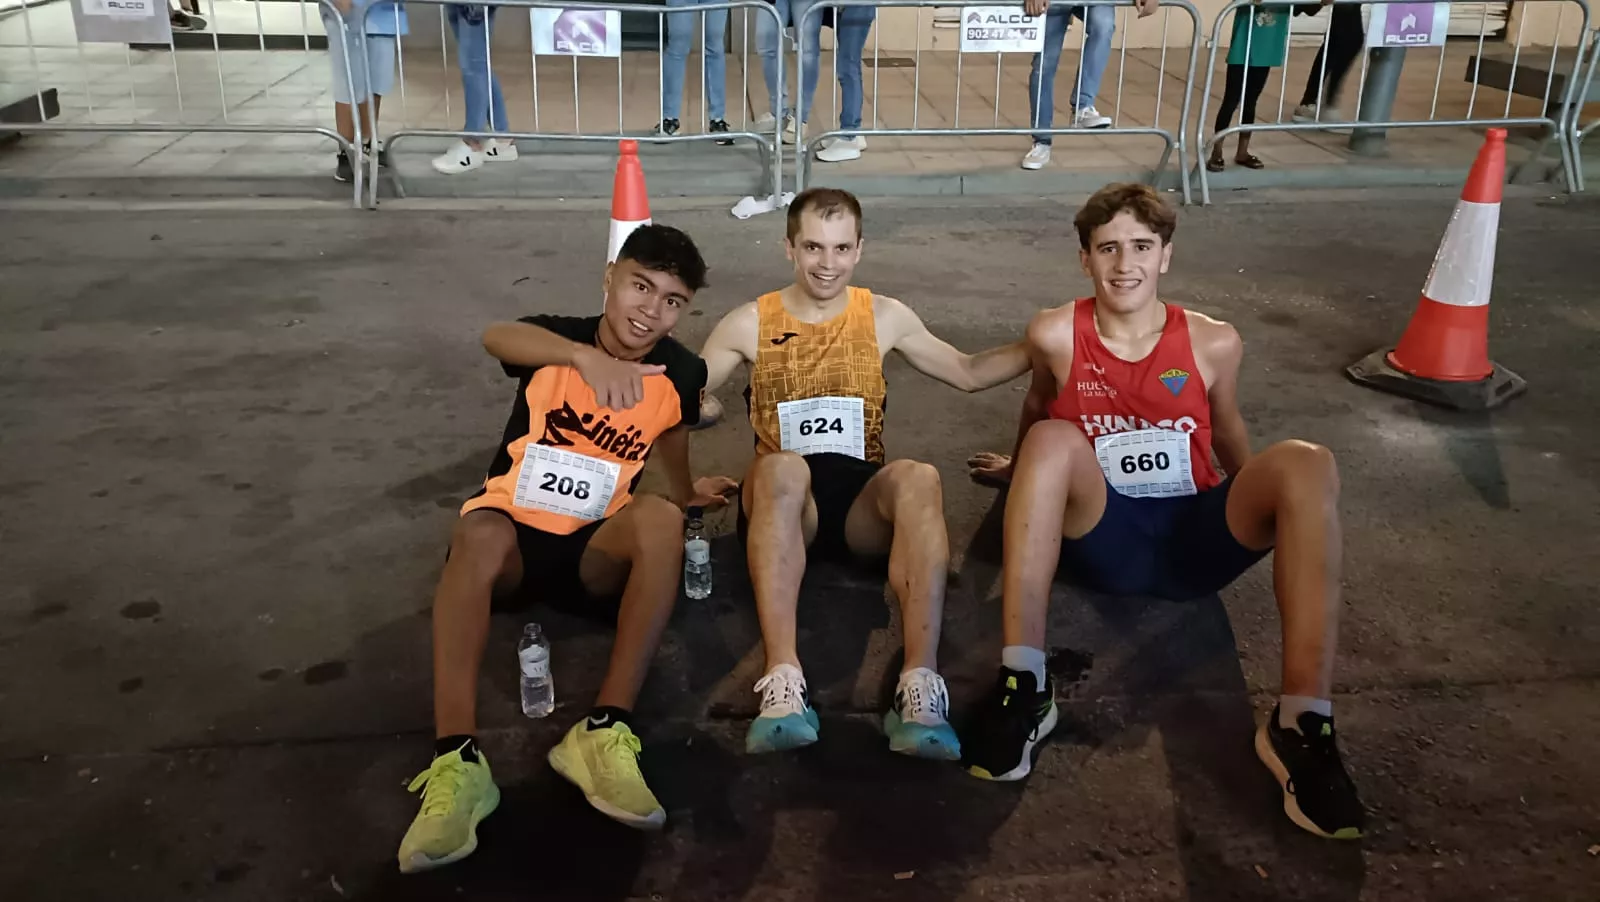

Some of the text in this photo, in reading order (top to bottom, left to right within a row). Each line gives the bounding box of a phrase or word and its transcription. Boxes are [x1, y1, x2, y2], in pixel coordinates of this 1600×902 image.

[108, 1, 144, 9] ALCO
[985, 15, 1033, 24] ALCO
[968, 29, 989, 39] 902
[1386, 33, 1428, 43] ALCO
[799, 417, 844, 436] 624
[1120, 451, 1170, 474] 660
[539, 472, 591, 500] 208
